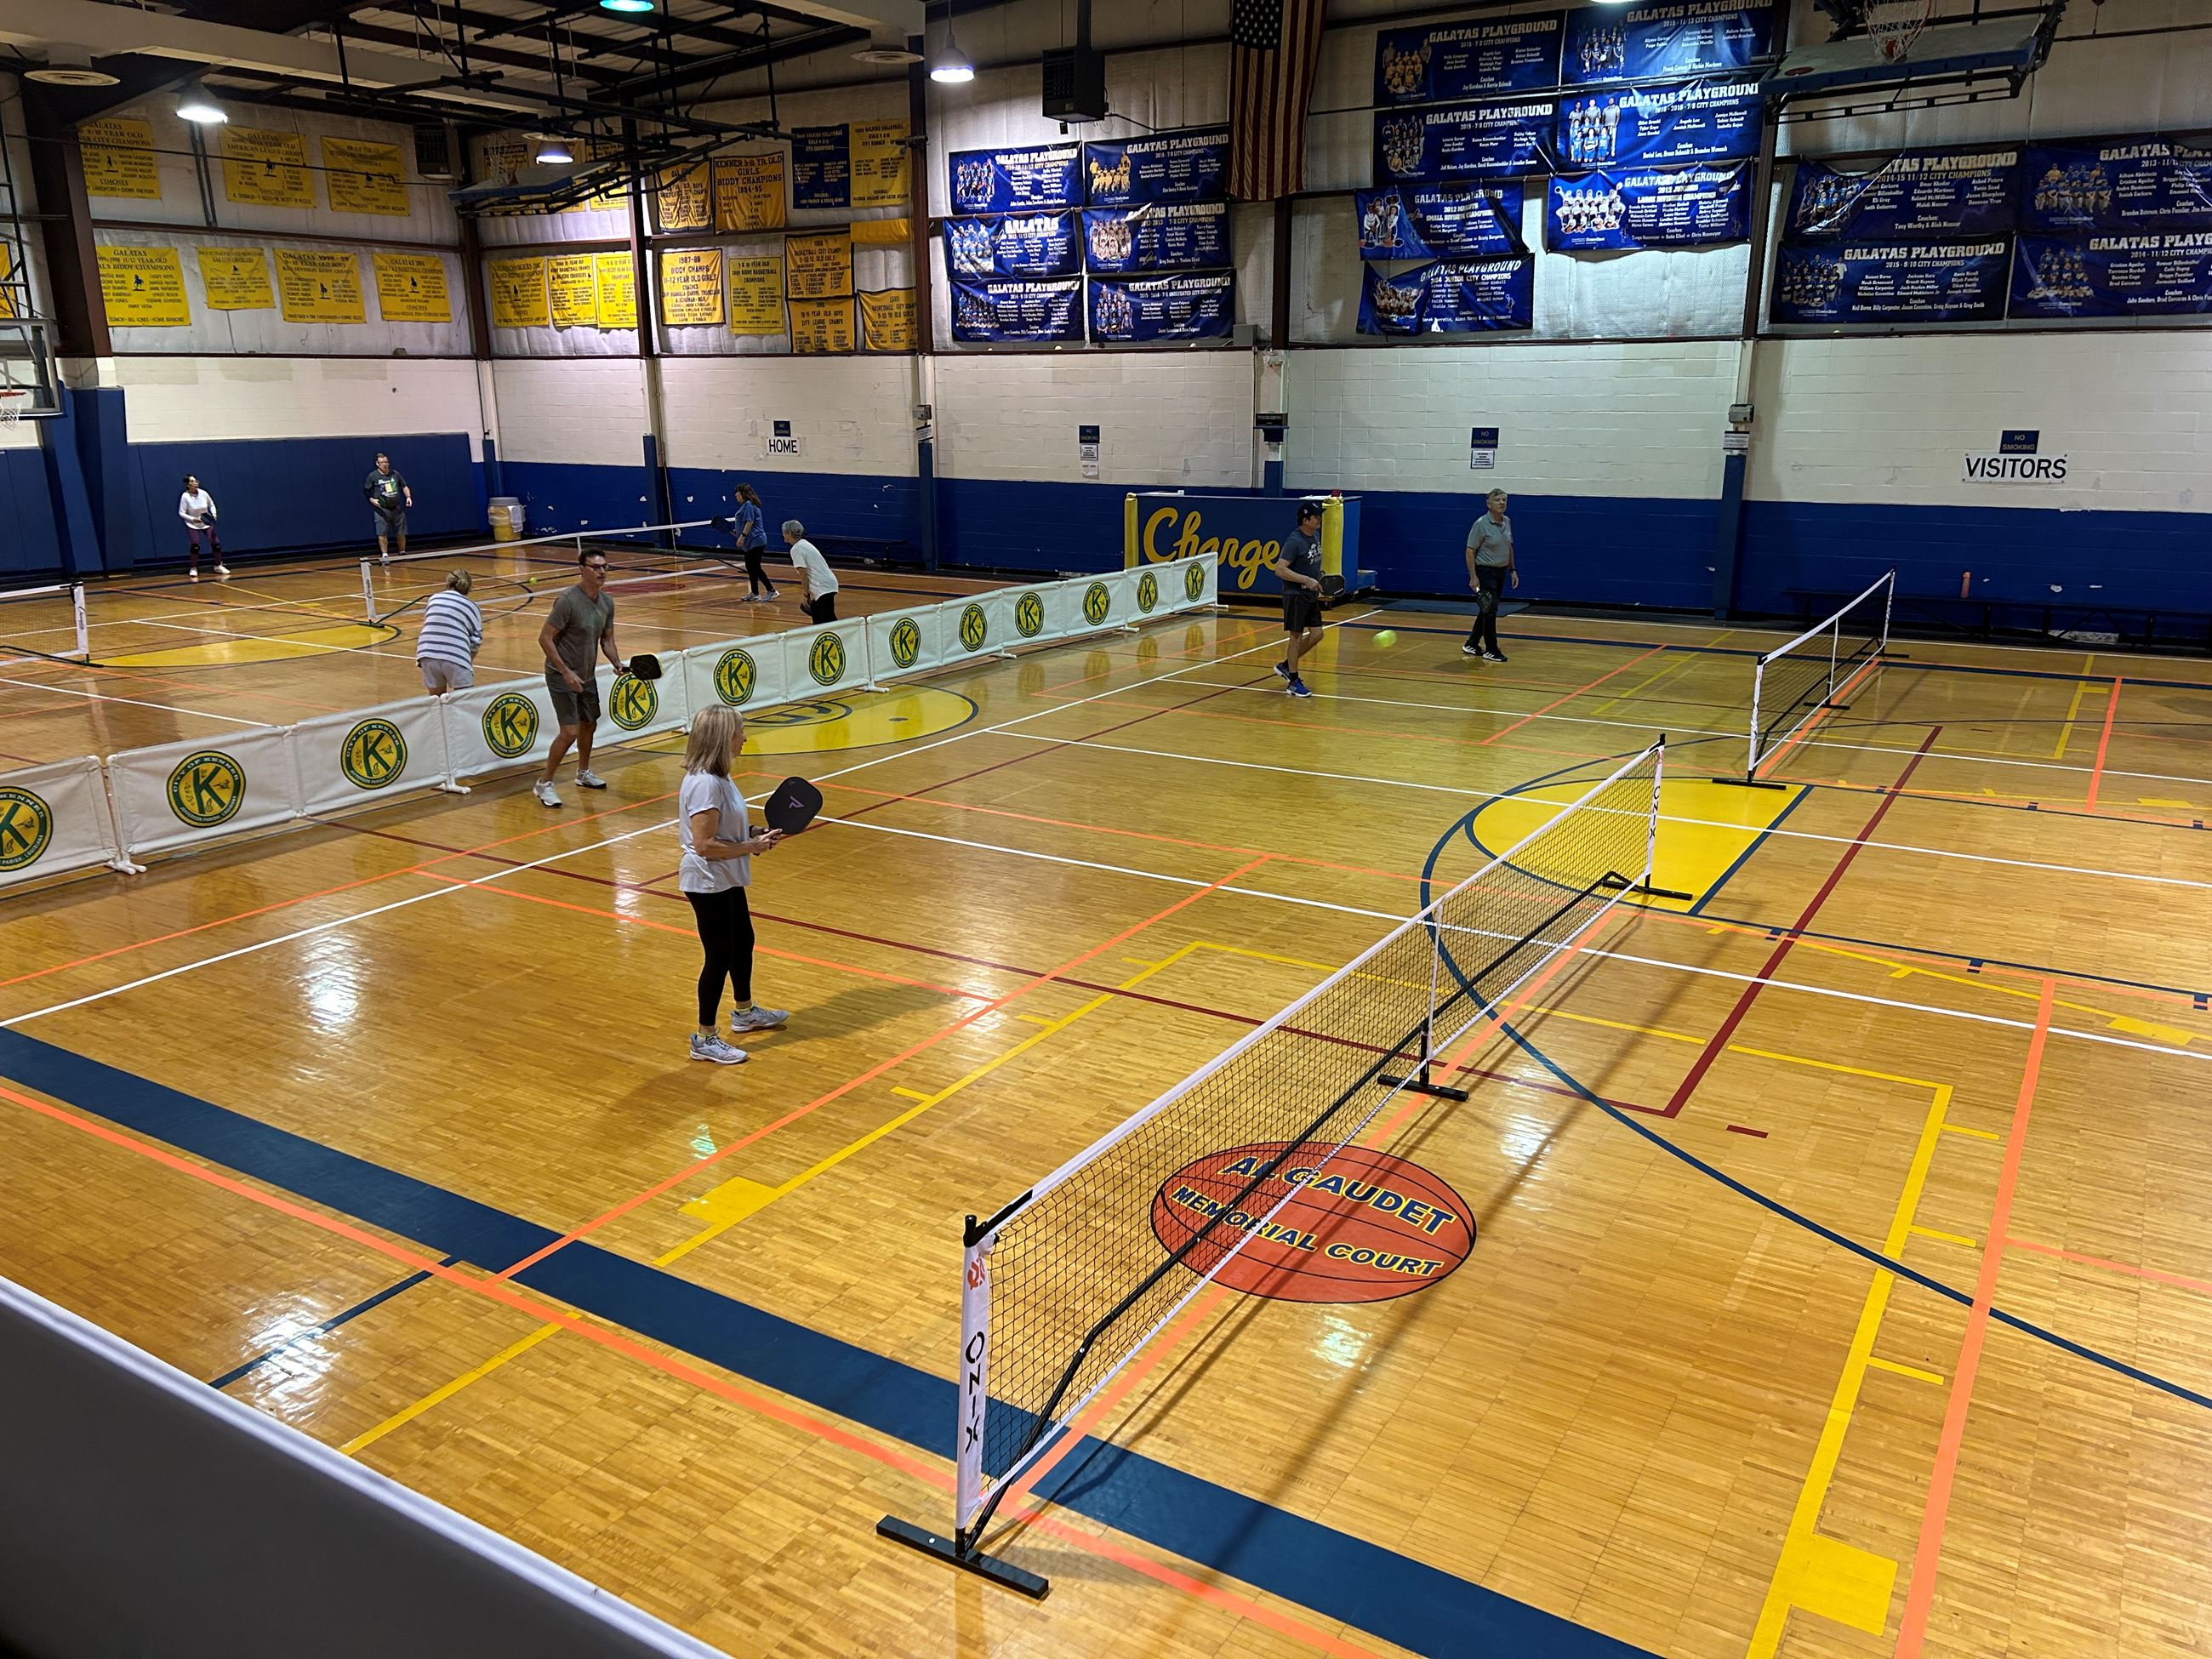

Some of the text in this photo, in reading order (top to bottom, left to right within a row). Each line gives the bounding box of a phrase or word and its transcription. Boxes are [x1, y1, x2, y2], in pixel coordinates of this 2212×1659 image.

[1627, 6, 1685, 22] GALATAS
[1708, 14, 1738, 22] CHAMPIONS
[1429, 20, 1557, 43] GALATAS PLAYGROUND
[1620, 83, 1759, 108] GALATAS PLAYGROUN
[1426, 104, 1553, 124] GALATAS PLAYGROUND
[1127, 134, 1229, 153] GALATAS PLAYGROUND
[2100, 144, 2169, 161] GALATAS
[1923, 151, 2017, 171] PLAYGROUND
[742, 174, 783, 185] CHAMPIONS
[1948, 169, 1991, 179] CHAMPIONS
[1415, 194, 1453, 203] GALATAS
[1168, 203, 1225, 218] PLAYGROUND
[1844, 242, 2005, 260] GALATAS PLAYGROUND
[2089, 236, 2159, 250] GALATAS
[1458, 260, 1522, 273] PLAYGROUND
[988, 281, 1080, 294] GALATAS PLAYGROUND
[1129, 277, 1230, 292] GALATAS PLAYGROUND
[769, 439, 798, 453] HOME
[1965, 458, 2067, 479] VISITORS
[1092, 591, 1103, 617] K
[1023, 601, 1037, 630] K
[967, 614, 981, 643] K
[899, 628, 912, 659] K
[821, 642, 836, 676] K
[728, 660, 744, 696] K
[625, 681, 646, 720] K
[501, 706, 524, 747] K
[362, 733, 391, 777] K
[192, 765, 225, 814] K
[1649, 786, 1661, 840] ONIX
[1219, 1155, 1457, 1236] AL GAUDET
[1169, 1184, 1445, 1277] MEMORIAL COURT
[965, 1331, 985, 1455] ONIX
